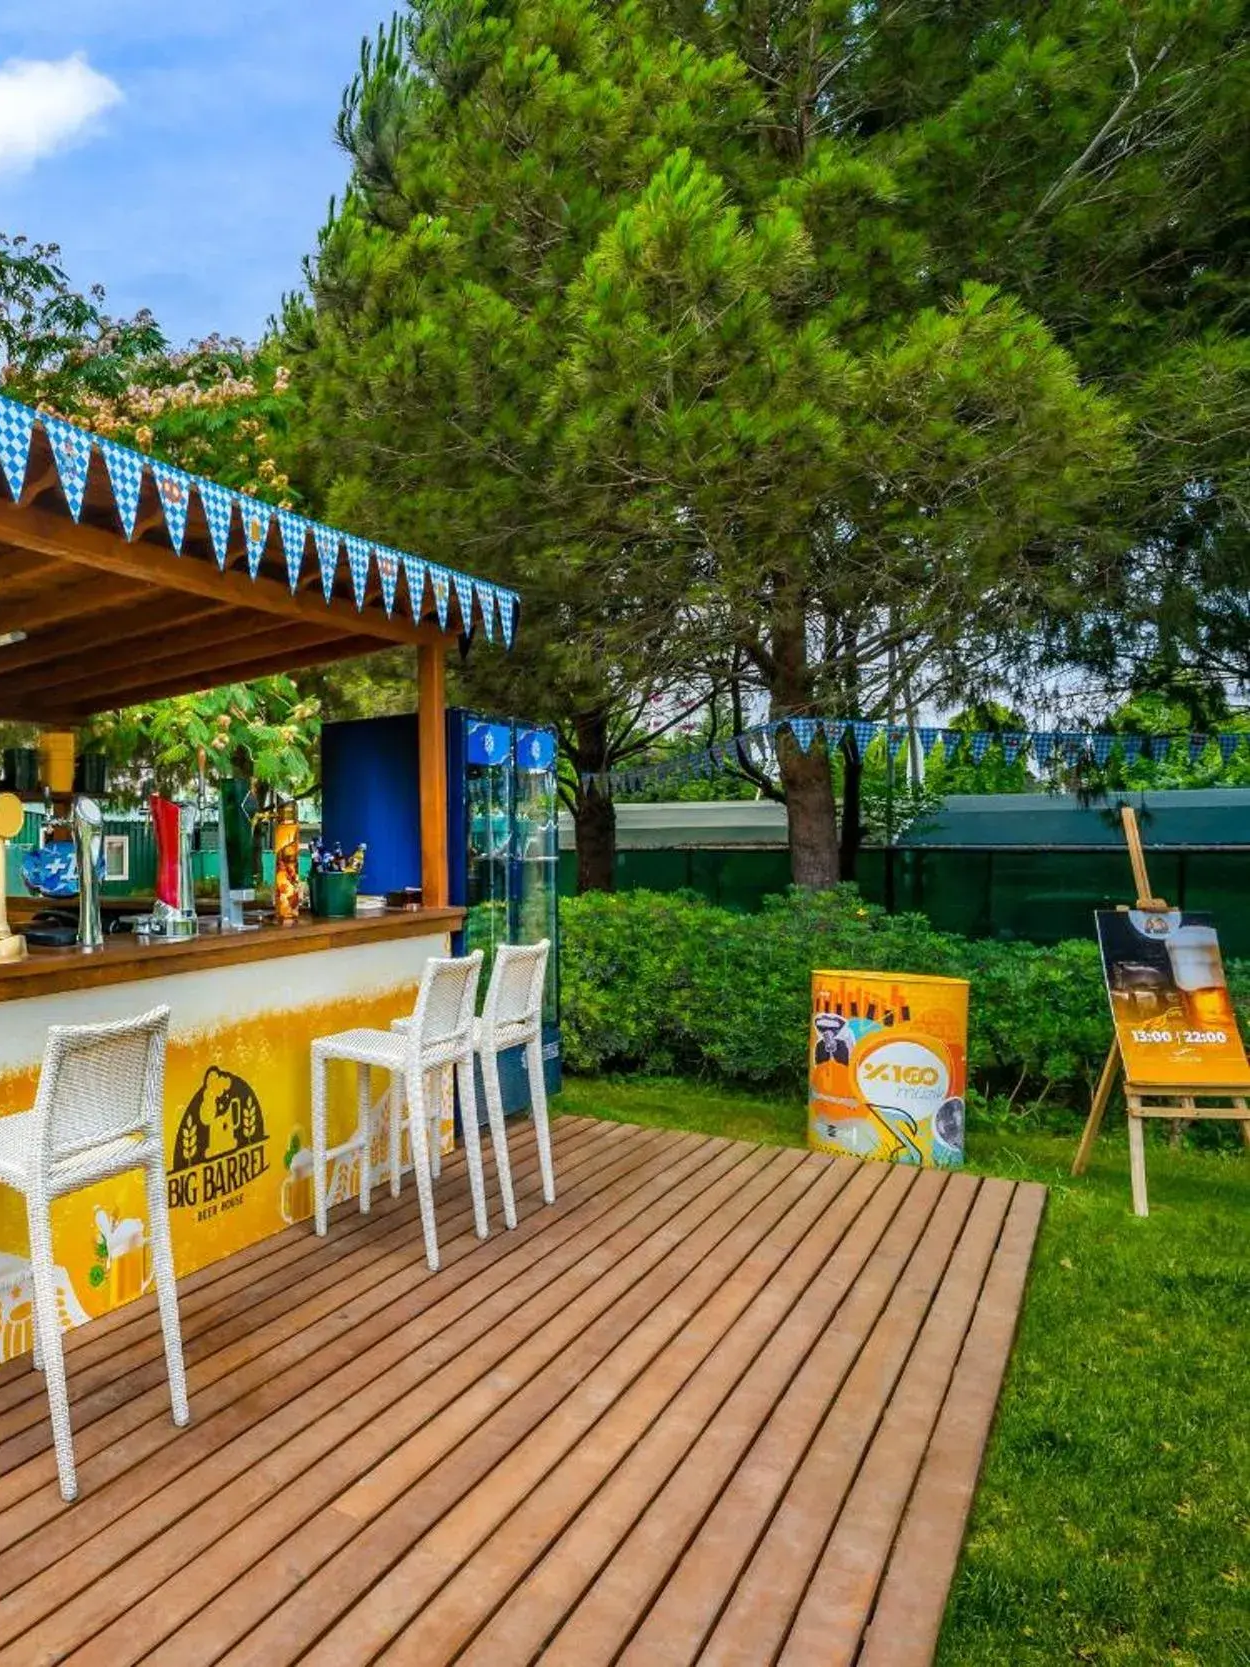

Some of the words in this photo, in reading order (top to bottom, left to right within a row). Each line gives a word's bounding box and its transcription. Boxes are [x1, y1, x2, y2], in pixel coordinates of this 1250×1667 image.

[1131, 1029, 1172, 1043] 13:00
[1183, 1030, 1227, 1044] 22:00
[168, 1171, 199, 1209] BIG
[203, 1145, 271, 1203] BARREL
[198, 1205, 217, 1222] BEER
[221, 1193, 244, 1211] HOUSE
